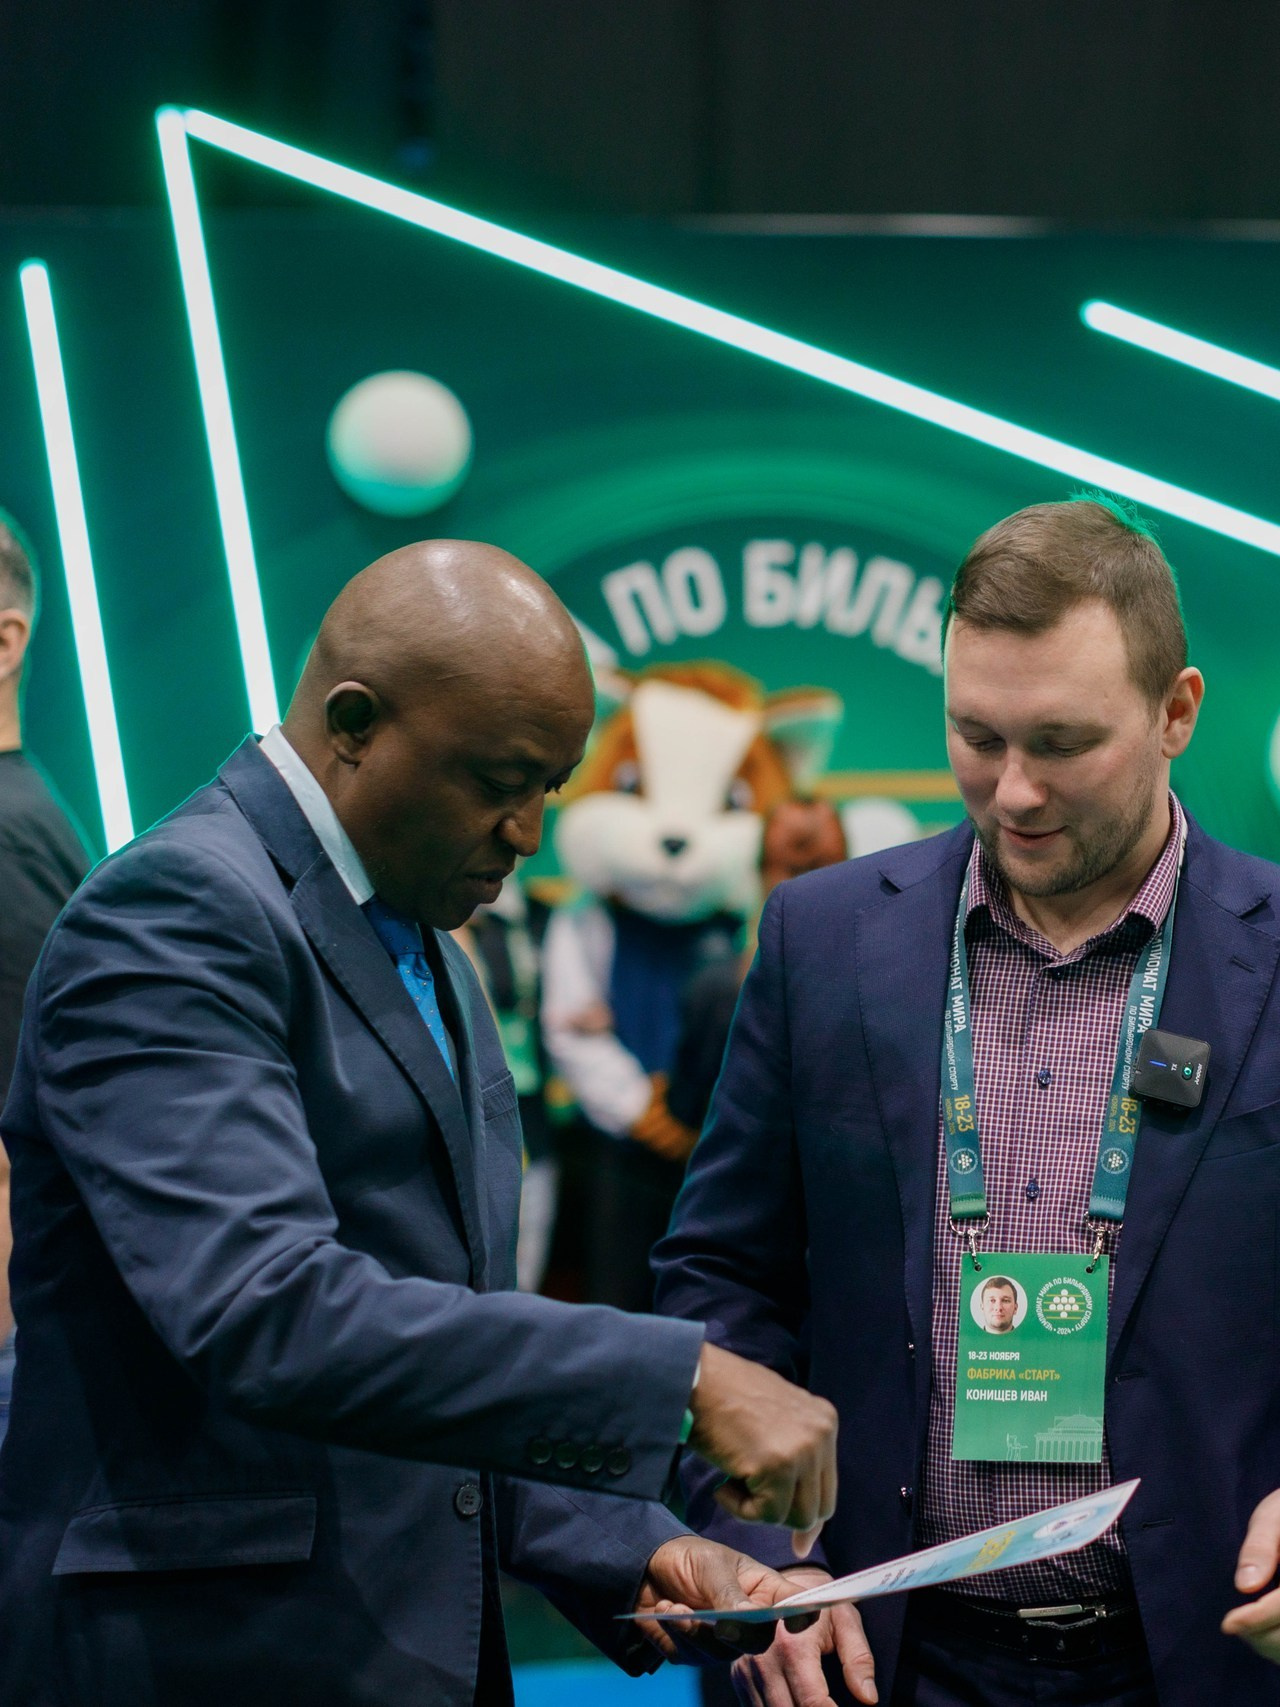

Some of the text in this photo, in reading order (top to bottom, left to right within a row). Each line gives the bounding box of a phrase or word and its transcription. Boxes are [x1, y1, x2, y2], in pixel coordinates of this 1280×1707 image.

[602, 546, 727, 657] ПО
[742, 539, 946, 676] БИЛЬ
[951, 994, 967, 1034] МИРА
[1137, 995, 1156, 1033] МИРА
[944, 1010, 952, 1020] ПО
[949, 1066, 959, 1091] СПОРТУ
[1121, 1005, 1137, 1090] ПО БИЛЬЯРДНОМУ СПОРТУ
[954, 1094, 974, 1132] 18-23
[1119, 1097, 1137, 1134] 18-23
[1036, 1277, 1093, 1331] ЧЕМПИОНАТ МИРА ПО БИЛЬЯРДНОМУ СПОРТУ
[1056, 1327, 1071, 1335] 2024
[967, 1367, 1060, 1381] ФАБРИКА «СТАРТ»
[968, 1351, 1020, 1361] 18-23 НОЯБРЯ
[966, 1389, 1048, 1402] КОНИЩЕВ ИВАН
